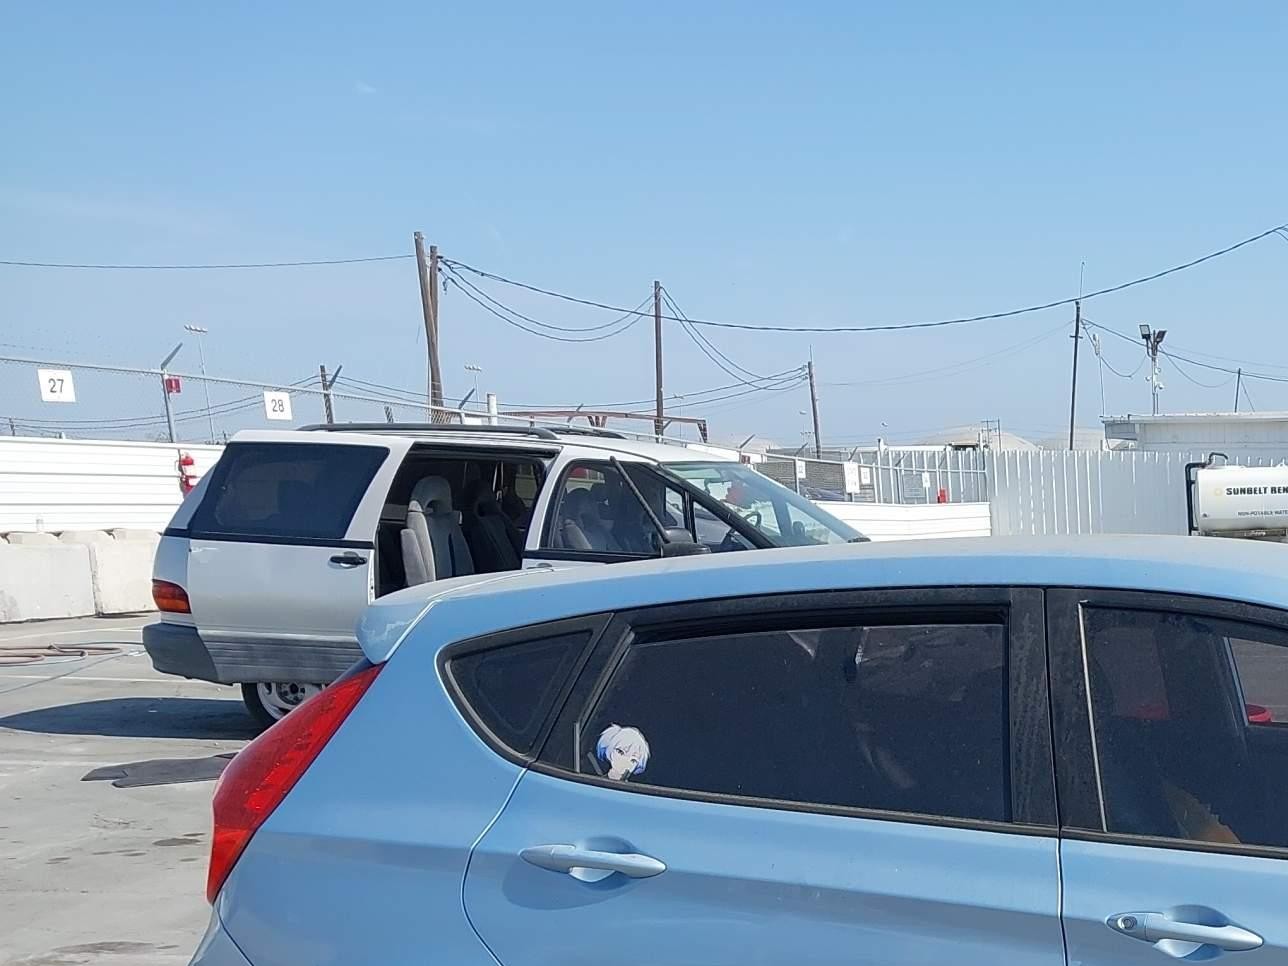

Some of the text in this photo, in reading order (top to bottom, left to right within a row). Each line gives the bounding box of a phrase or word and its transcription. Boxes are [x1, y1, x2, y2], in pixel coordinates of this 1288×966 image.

[47, 378, 65, 394] 27
[270, 398, 285, 413] 28
[1225, 486, 1268, 496] SUNBELT
